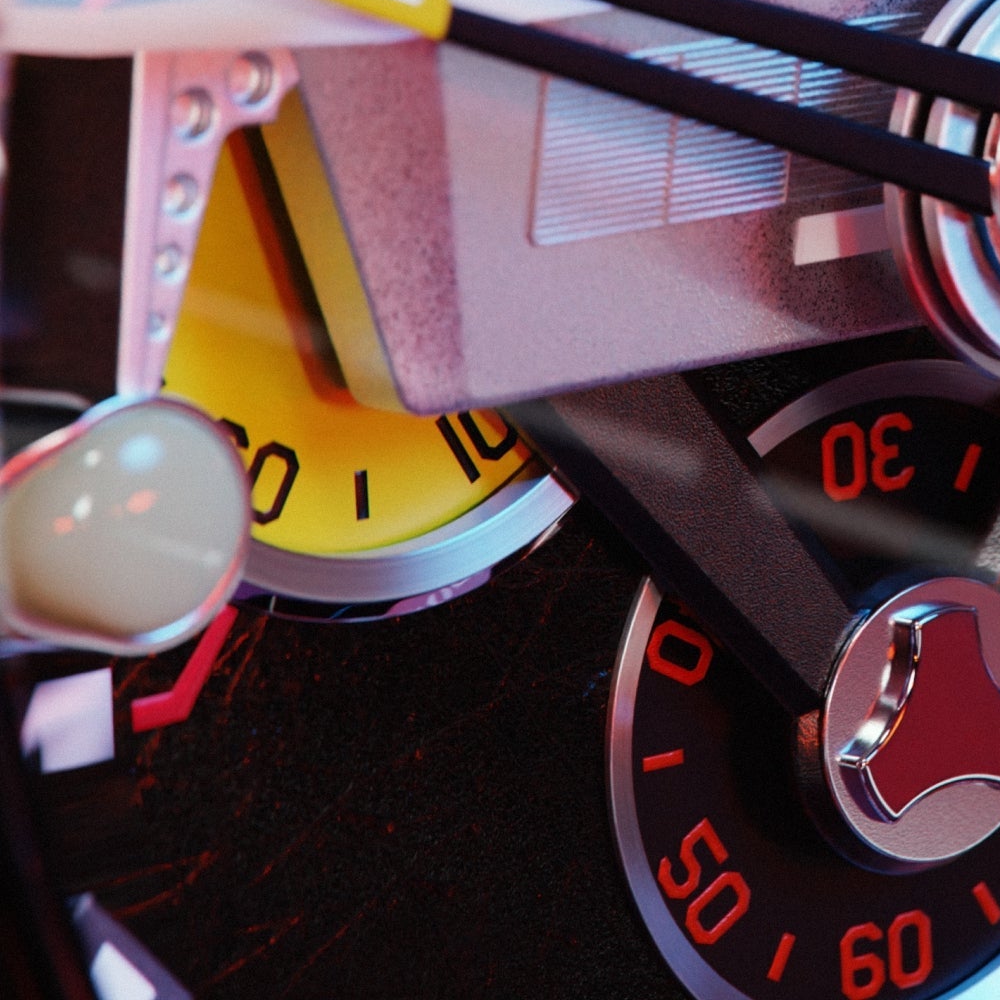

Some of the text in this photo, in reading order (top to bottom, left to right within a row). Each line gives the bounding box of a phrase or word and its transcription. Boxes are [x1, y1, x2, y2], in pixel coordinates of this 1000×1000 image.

[822, 411, 915, 502] 30
[657, 817, 751, 945] 50
[839, 909, 933, 1000] 60
